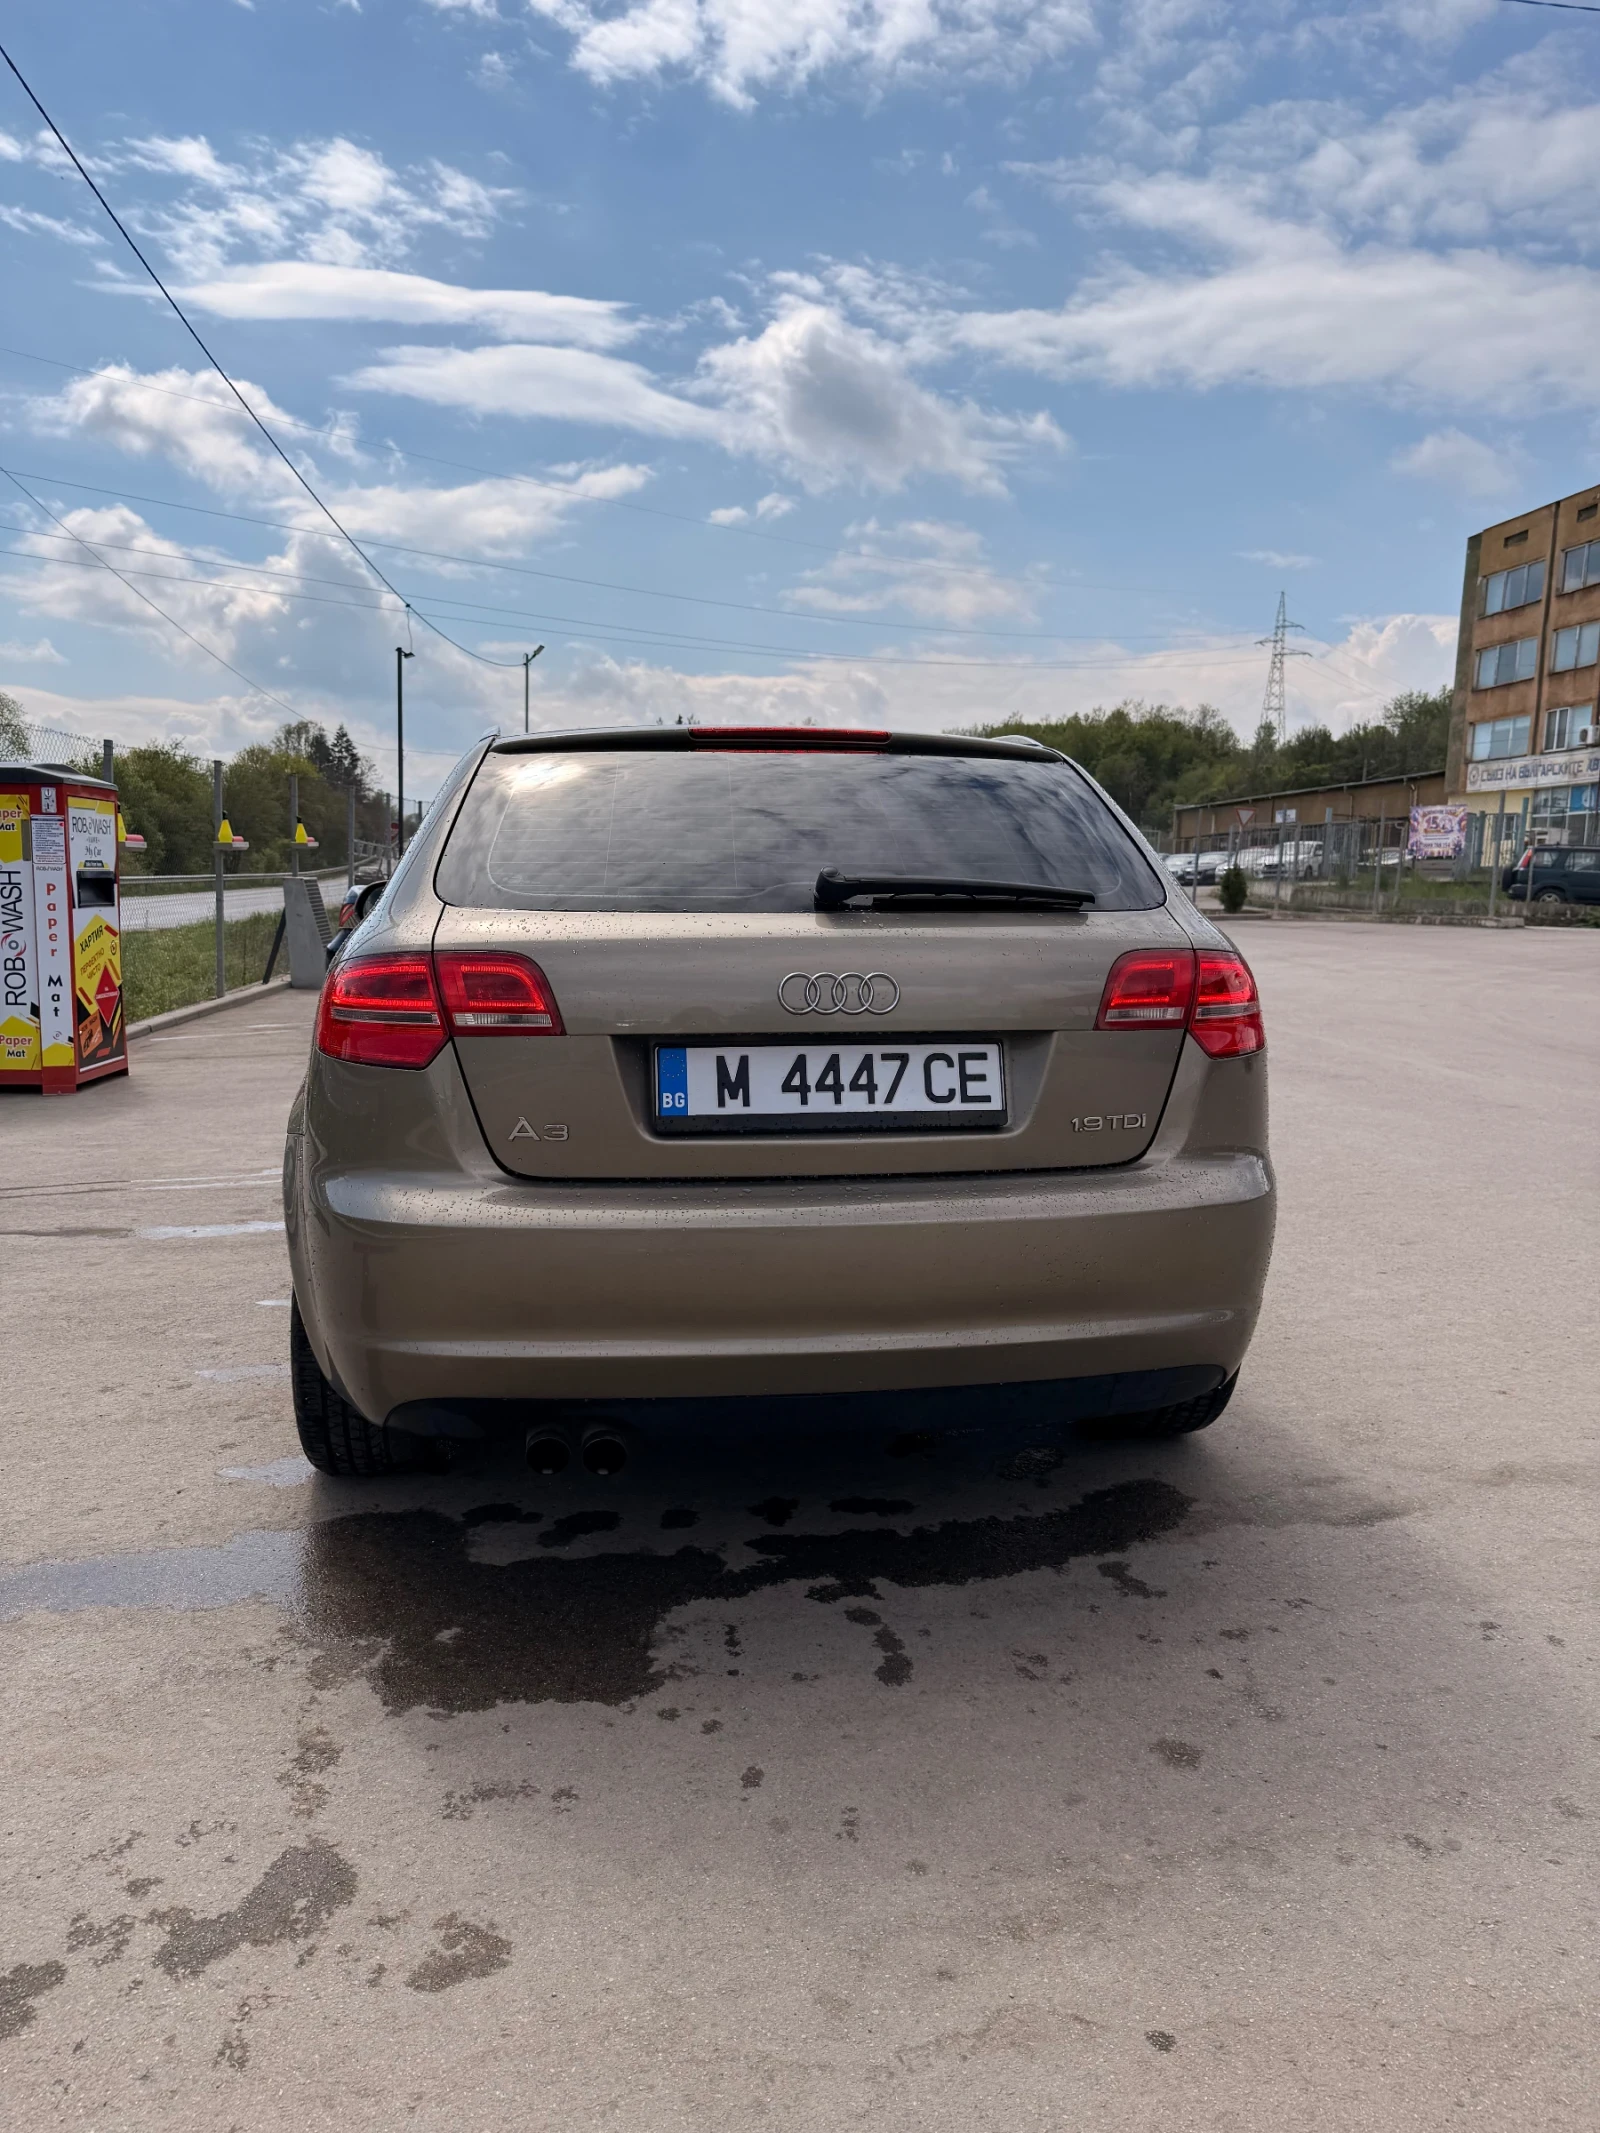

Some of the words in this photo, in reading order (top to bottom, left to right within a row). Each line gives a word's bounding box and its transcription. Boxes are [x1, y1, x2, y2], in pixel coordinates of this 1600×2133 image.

[1505, 765, 1517, 780] НА
[47, 883, 58, 957] Paper
[80, 925, 104, 954] ХАРТИЯ
[80, 947, 105, 976] ПЕРФЕКТНО
[87, 963, 101, 980] ЧИСТО
[48, 975, 63, 1017] Mat
[0, 1035, 32, 1047] Paper
[7, 1049, 26, 1058] Mat
[716, 1055, 751, 1108] M
[781, 1053, 910, 1105] 4447
[923, 1053, 992, 1104] CE
[662, 1092, 685, 1108] BG
[508, 1116, 569, 1142] A3
[1106, 1113, 1147, 1130] TDI
